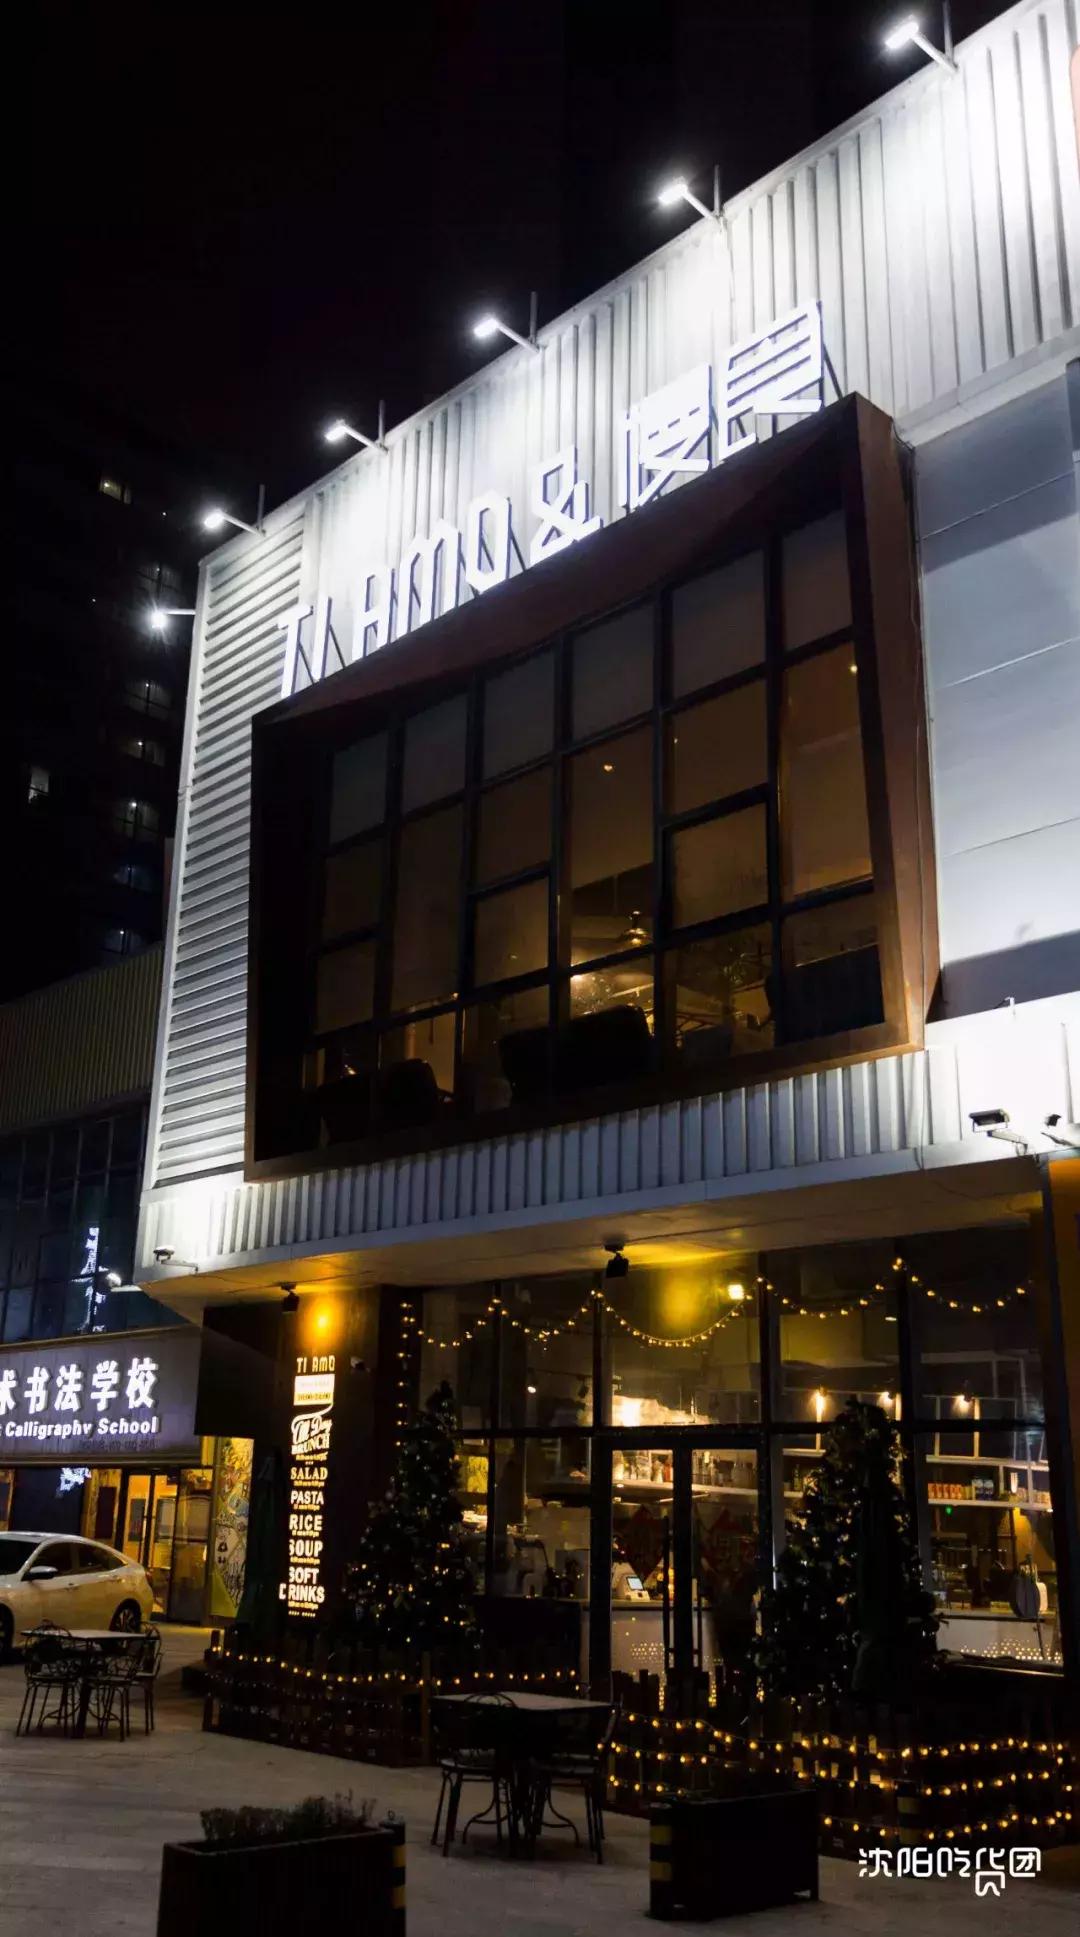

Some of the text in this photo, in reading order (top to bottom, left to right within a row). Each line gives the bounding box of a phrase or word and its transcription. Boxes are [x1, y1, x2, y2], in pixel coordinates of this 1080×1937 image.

[5, 1418, 93, 1440] Calligraphy
[97, 1416, 159, 1435] School
[290, 1466, 328, 1480] SALAD
[290, 1490, 324, 1505] PASTA
[289, 1514, 323, 1531] RICE
[288, 1539, 324, 1557] SOUP
[288, 1566, 320, 1584] SOFT
